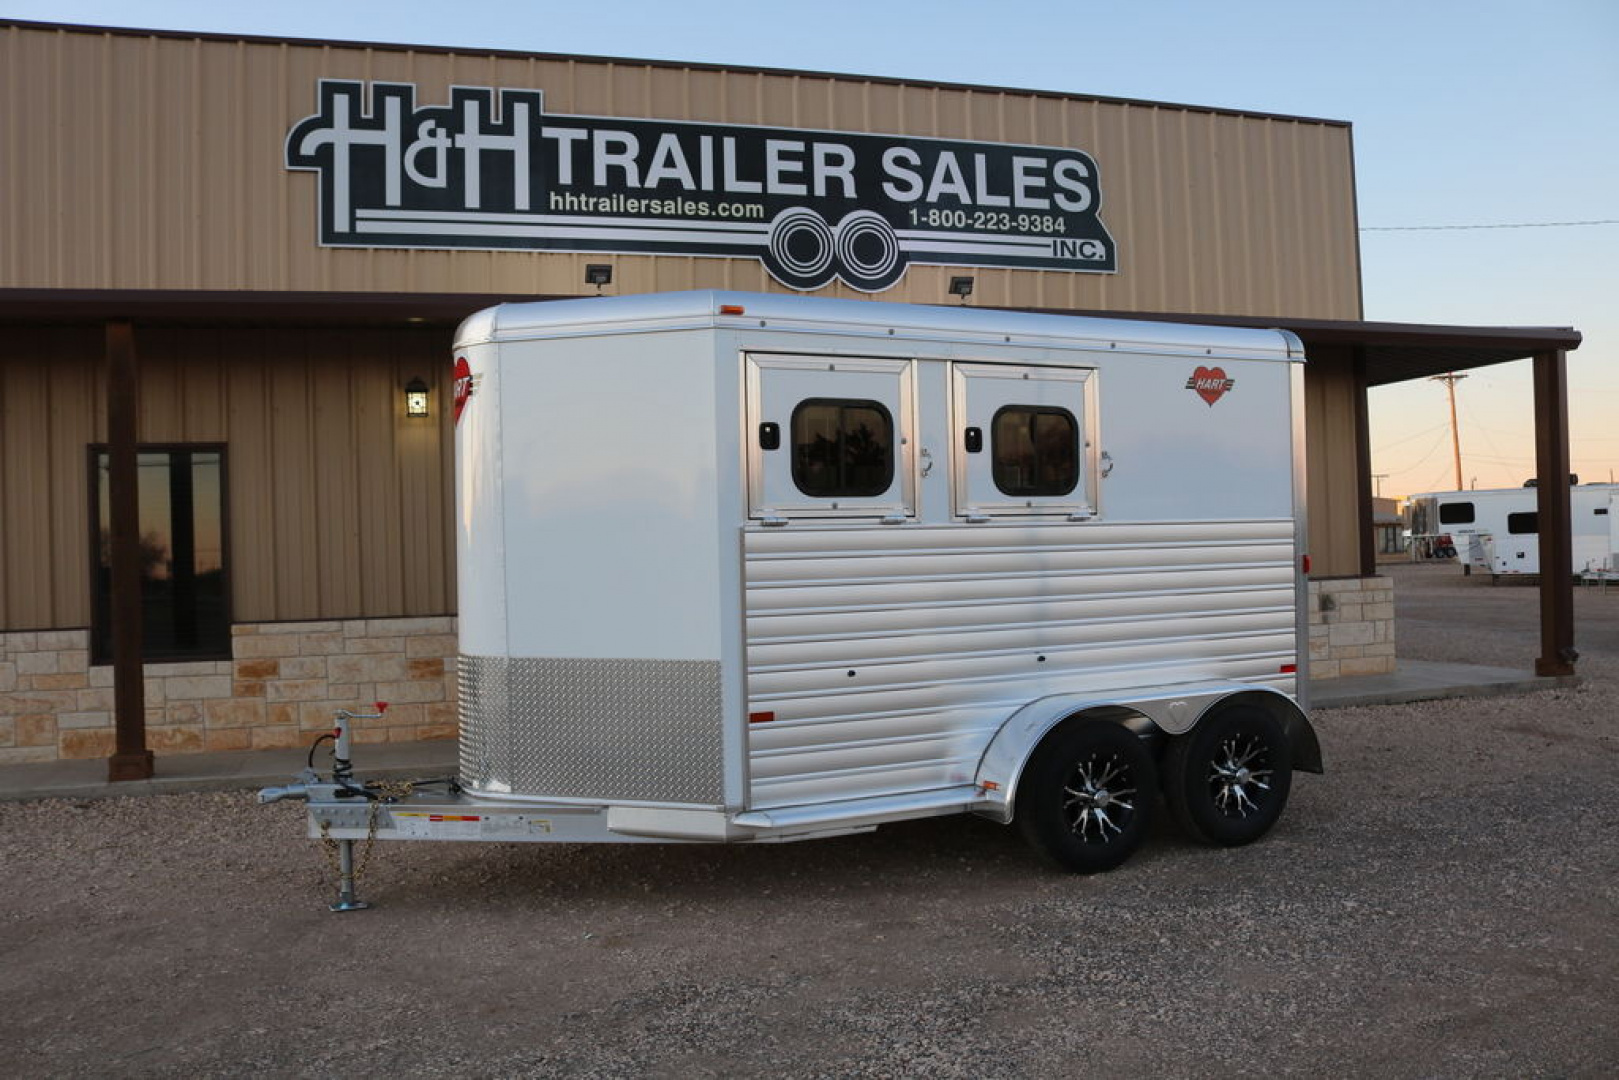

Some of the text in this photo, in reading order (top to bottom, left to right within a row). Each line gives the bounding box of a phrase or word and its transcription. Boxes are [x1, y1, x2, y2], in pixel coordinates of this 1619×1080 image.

[300, 93, 1092, 233] H&H TRAILER SALES
[549, 191, 765, 218] hhtrailersales.com
[908, 208, 1067, 233] 1-800-223-9384
[1052, 239, 1105, 260] INC.
[1196, 377, 1225, 390] HART
